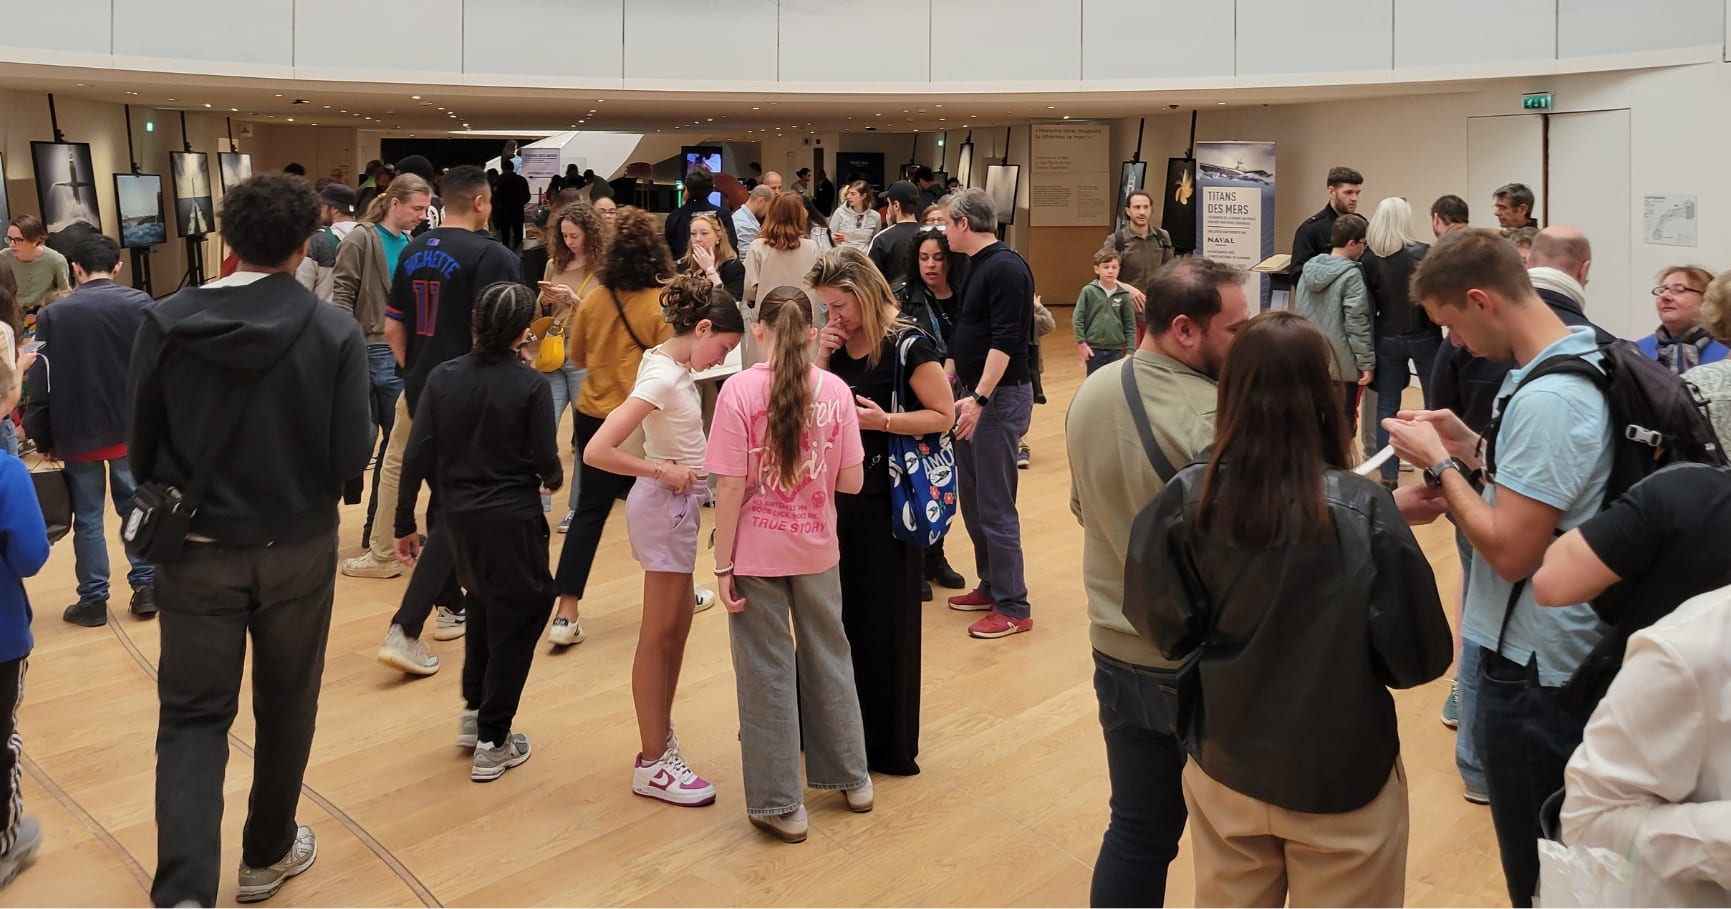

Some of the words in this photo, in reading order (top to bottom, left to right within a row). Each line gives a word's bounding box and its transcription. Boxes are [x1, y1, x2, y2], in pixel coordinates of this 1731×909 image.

[1207, 191, 1237, 202] TITANS
[1207, 203, 1224, 214] DES
[1225, 204, 1249, 215] MERS
[1207, 236, 1236, 244] NAVAL
[751, 515, 788, 532] TRUE
[790, 520, 828, 534] STORY
